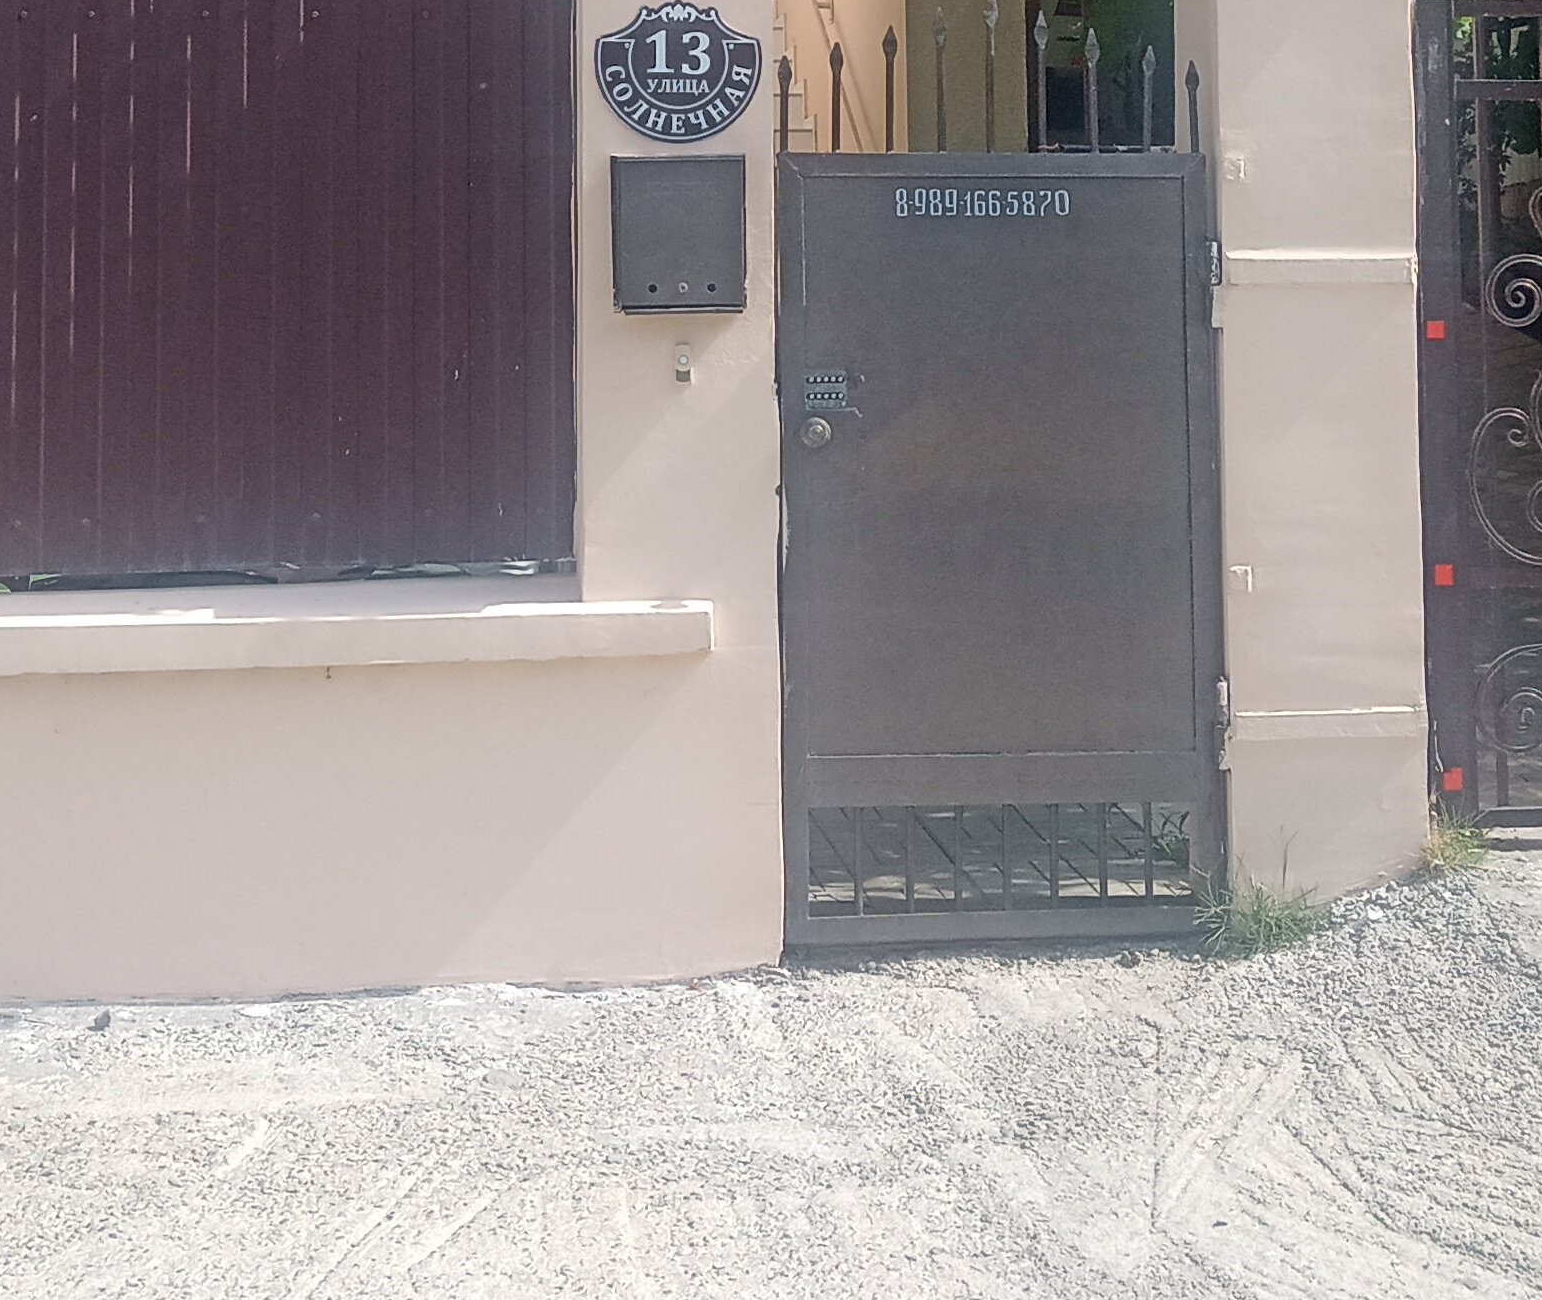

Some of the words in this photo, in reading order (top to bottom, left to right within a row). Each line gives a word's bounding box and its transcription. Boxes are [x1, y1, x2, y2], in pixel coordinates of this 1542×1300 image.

[646, 30, 710, 74] 13
[605, 64, 752, 133] СОЛНЕЧНАЯ
[647, 78, 710, 97] УЛИЦА
